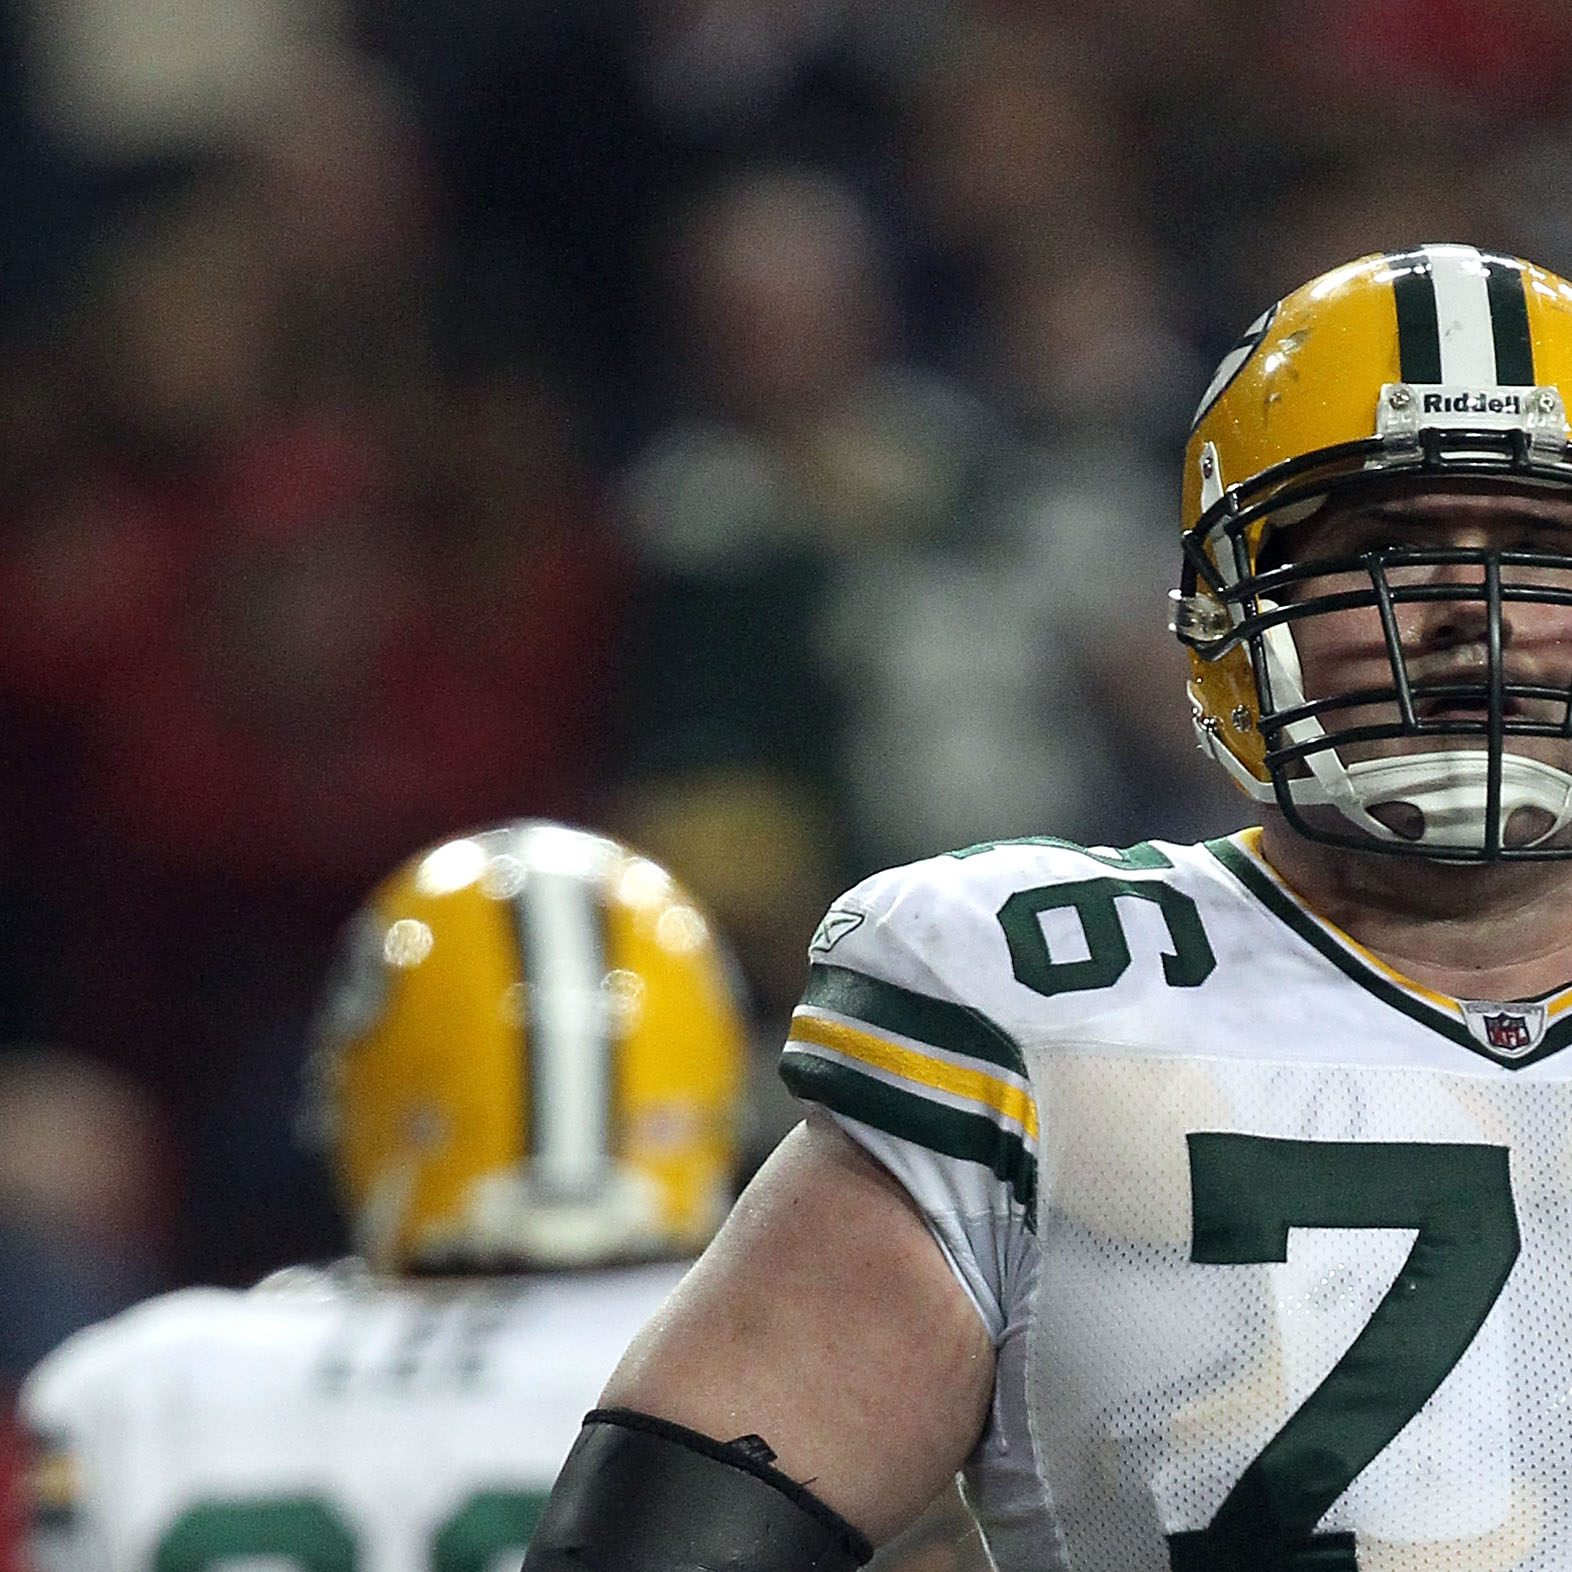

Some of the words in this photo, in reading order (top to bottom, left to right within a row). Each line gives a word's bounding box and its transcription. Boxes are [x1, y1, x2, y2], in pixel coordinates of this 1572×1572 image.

[1423, 392, 1521, 415] Riddell
[942, 836, 1217, 998] 6
[1488, 1026, 1529, 1047] NFL
